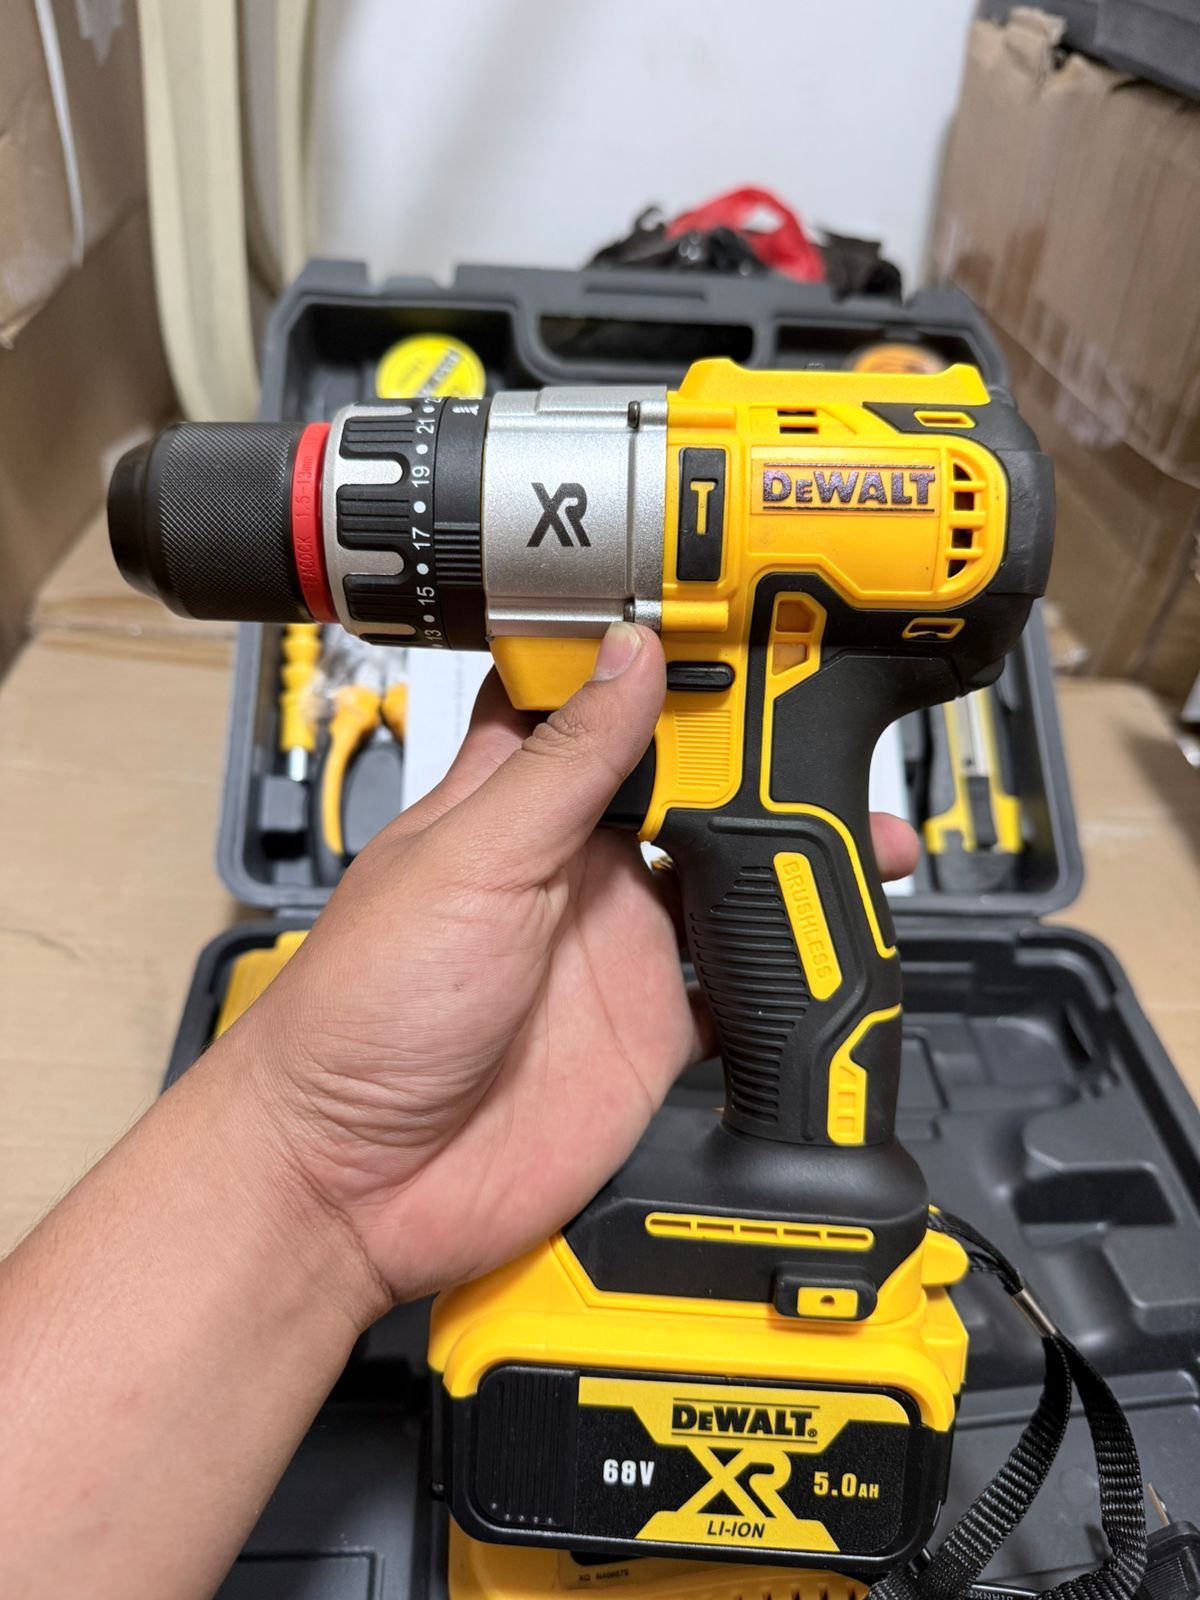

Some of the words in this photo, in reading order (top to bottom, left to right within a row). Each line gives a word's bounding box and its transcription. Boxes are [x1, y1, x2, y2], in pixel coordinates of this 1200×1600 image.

[416, 419, 436, 434] 21
[411, 466, 430, 488] 19
[526, 482, 592, 547] XR
[411, 526, 431, 550] 17
[416, 586, 436, 606] 15
[424, 629, 443, 641] 13
[782, 860, 833, 979] BRUSHLESS
[603, 1459, 655, 1487] 68V
[676, 1446, 798, 1518] XR
[707, 1520, 766, 1539] LI-ION
